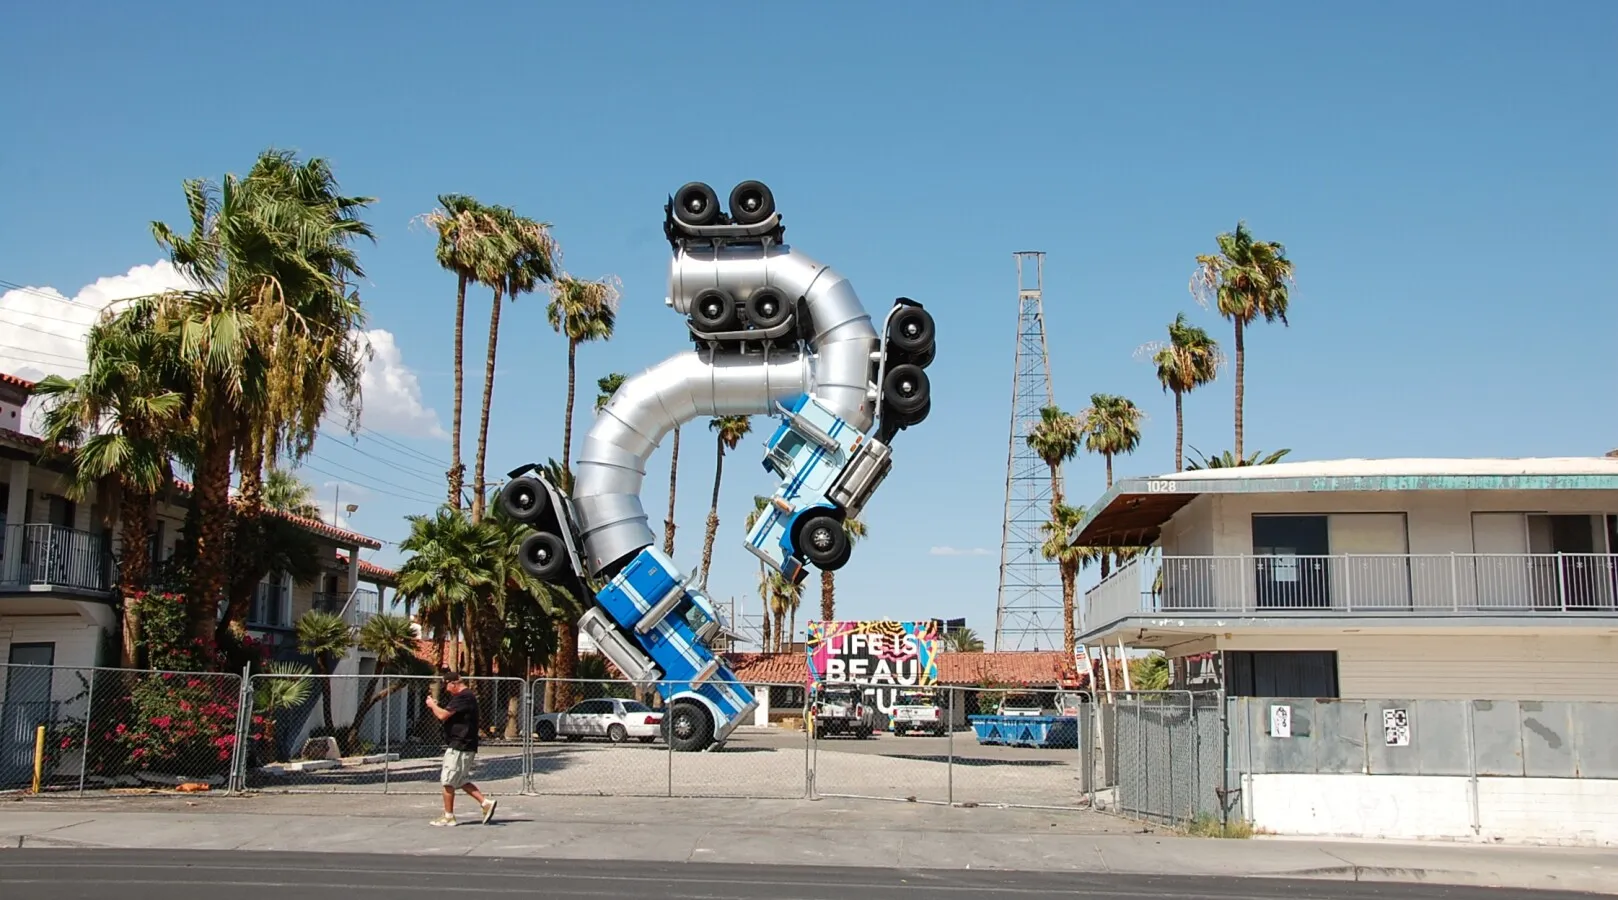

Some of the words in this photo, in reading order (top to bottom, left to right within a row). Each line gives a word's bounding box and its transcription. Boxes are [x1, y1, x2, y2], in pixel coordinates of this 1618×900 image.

[1146, 480, 1177, 492] 1028
[827, 634, 884, 655] LIFE
[894, 634, 917, 655] IS
[827, 659, 917, 685] BEAU
